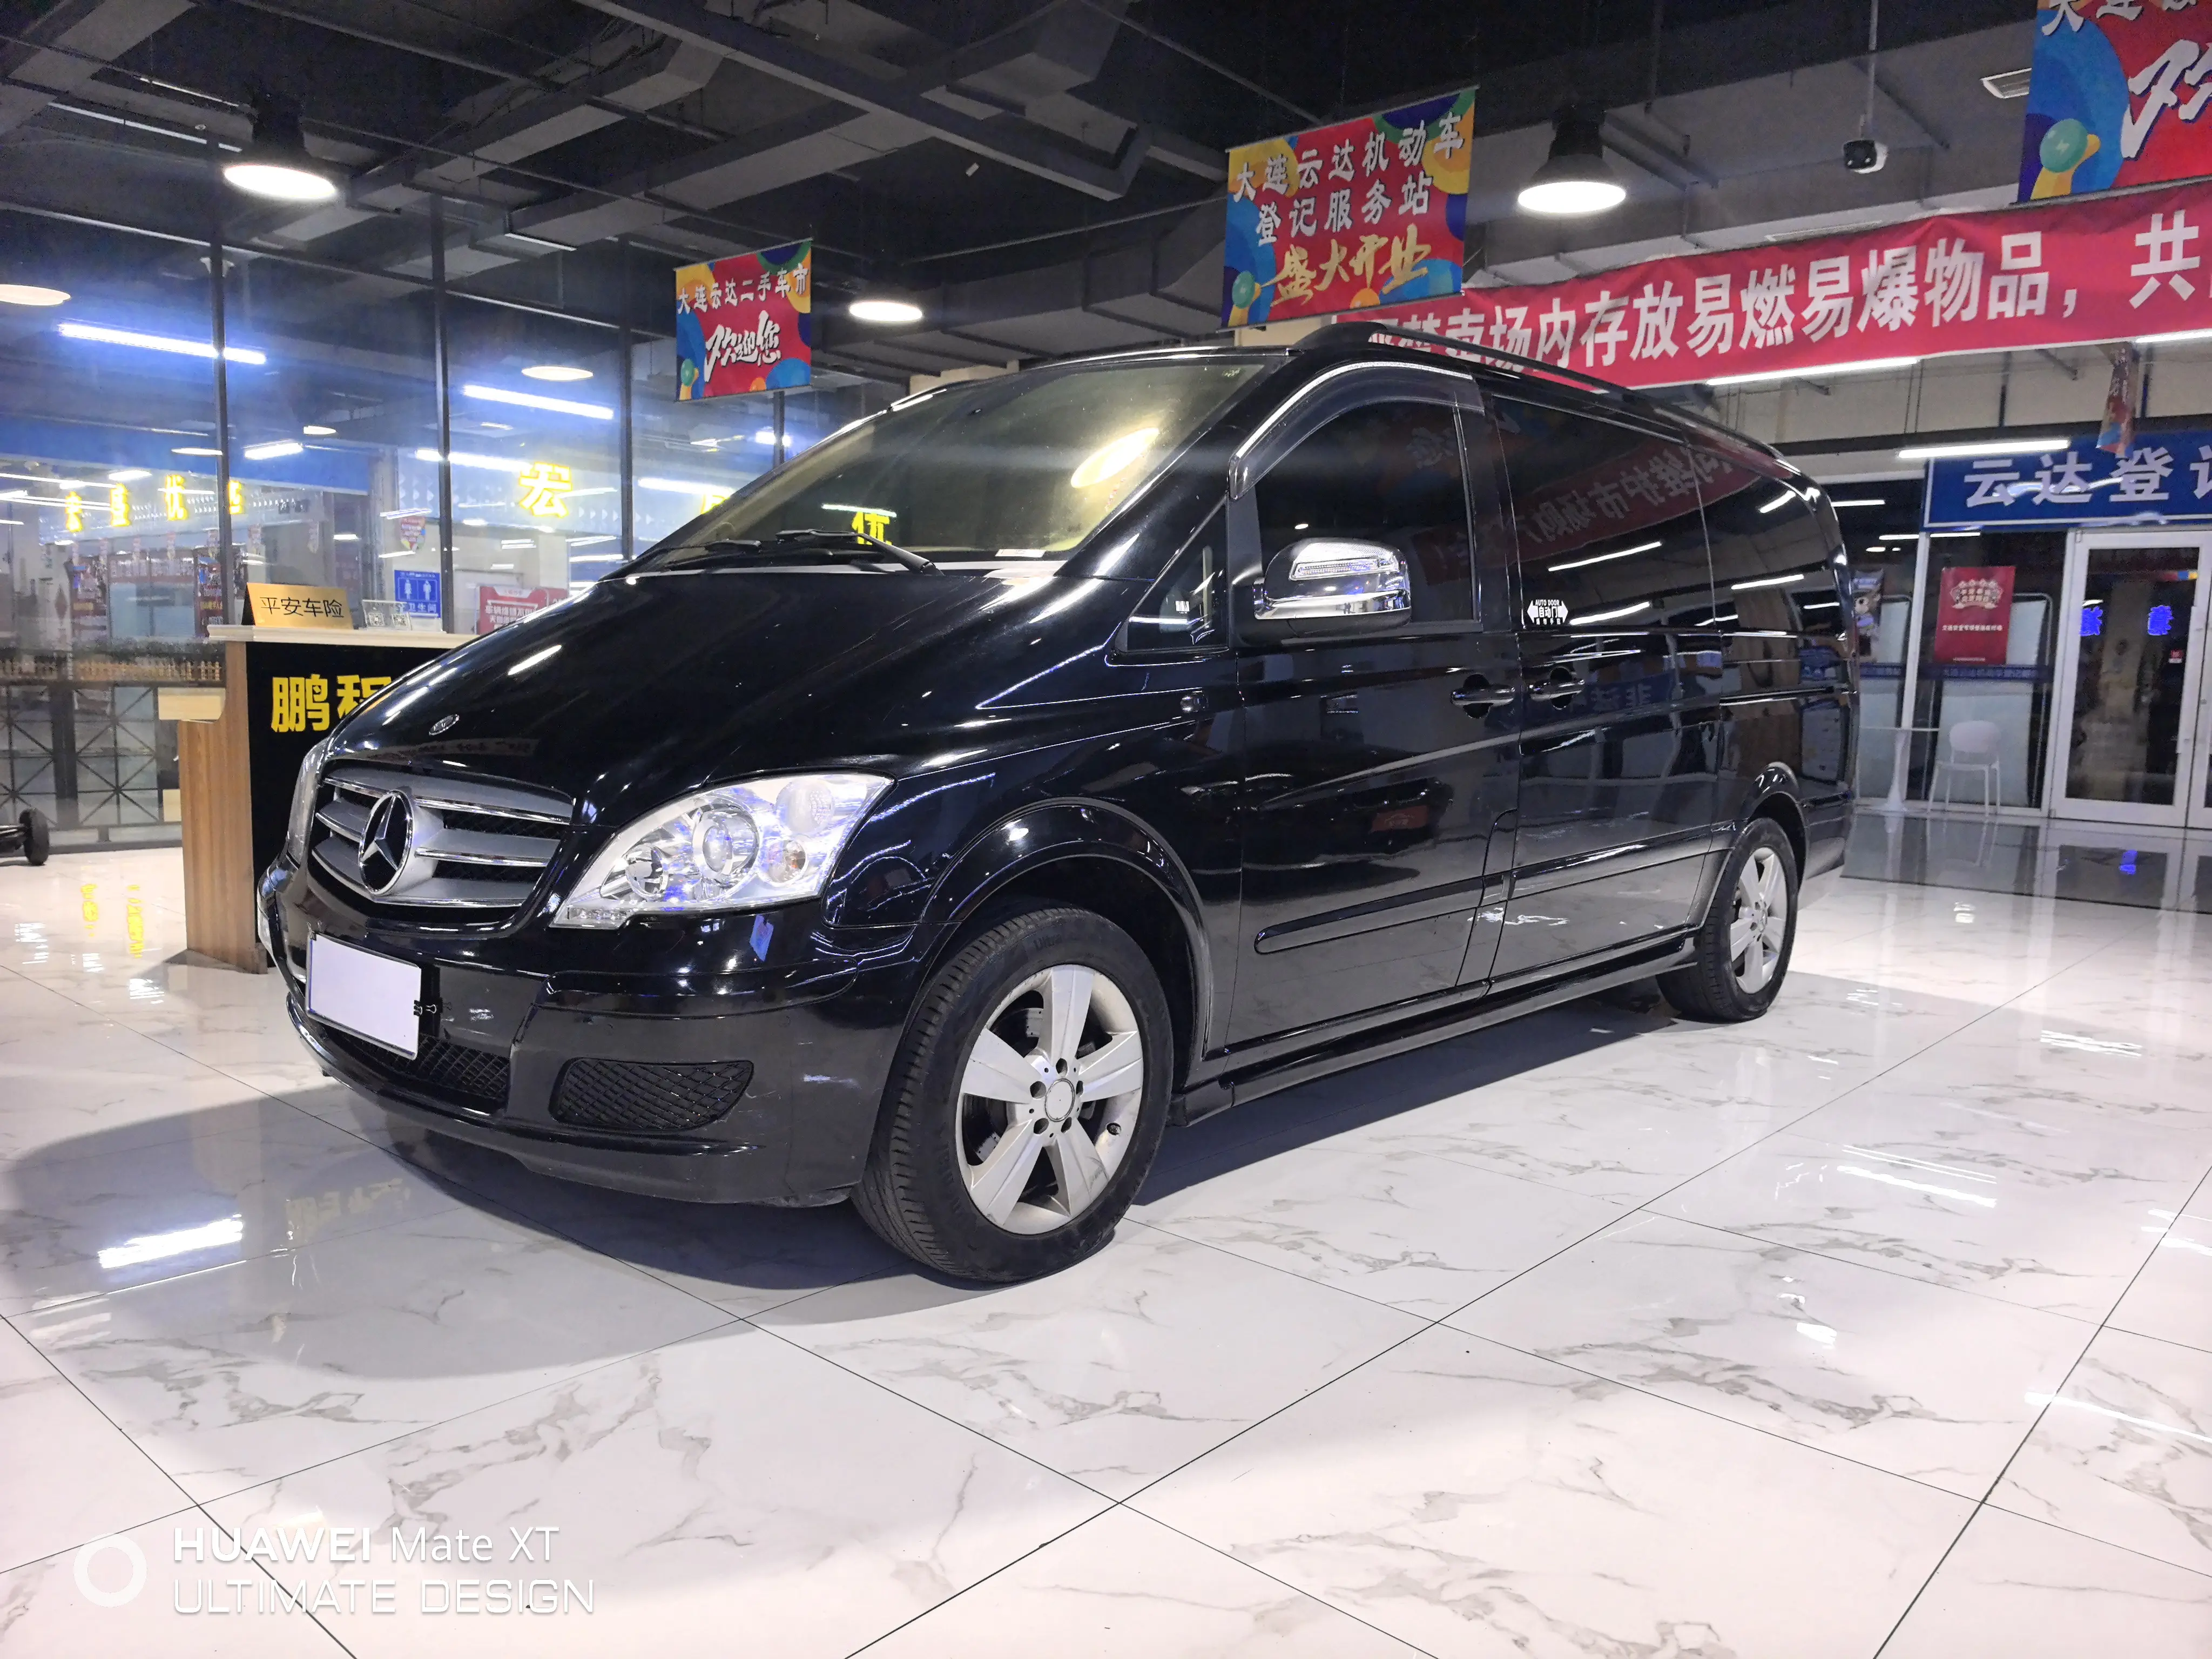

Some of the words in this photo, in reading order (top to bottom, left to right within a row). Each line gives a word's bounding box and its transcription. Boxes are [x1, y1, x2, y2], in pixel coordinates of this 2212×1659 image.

[1256, 171, 1433, 246] 登记服务站
[1260, 222, 1431, 307] 盛大开业
[1368, 209, 2212, 373] 禁卖场内存放易燃易爆物品，共
[704, 310, 781, 383] 欢迎您
[260, 597, 344, 618] 平安车险
[408, 602, 436, 613] 卫生间
[1539, 605, 1557, 618] 自动门
